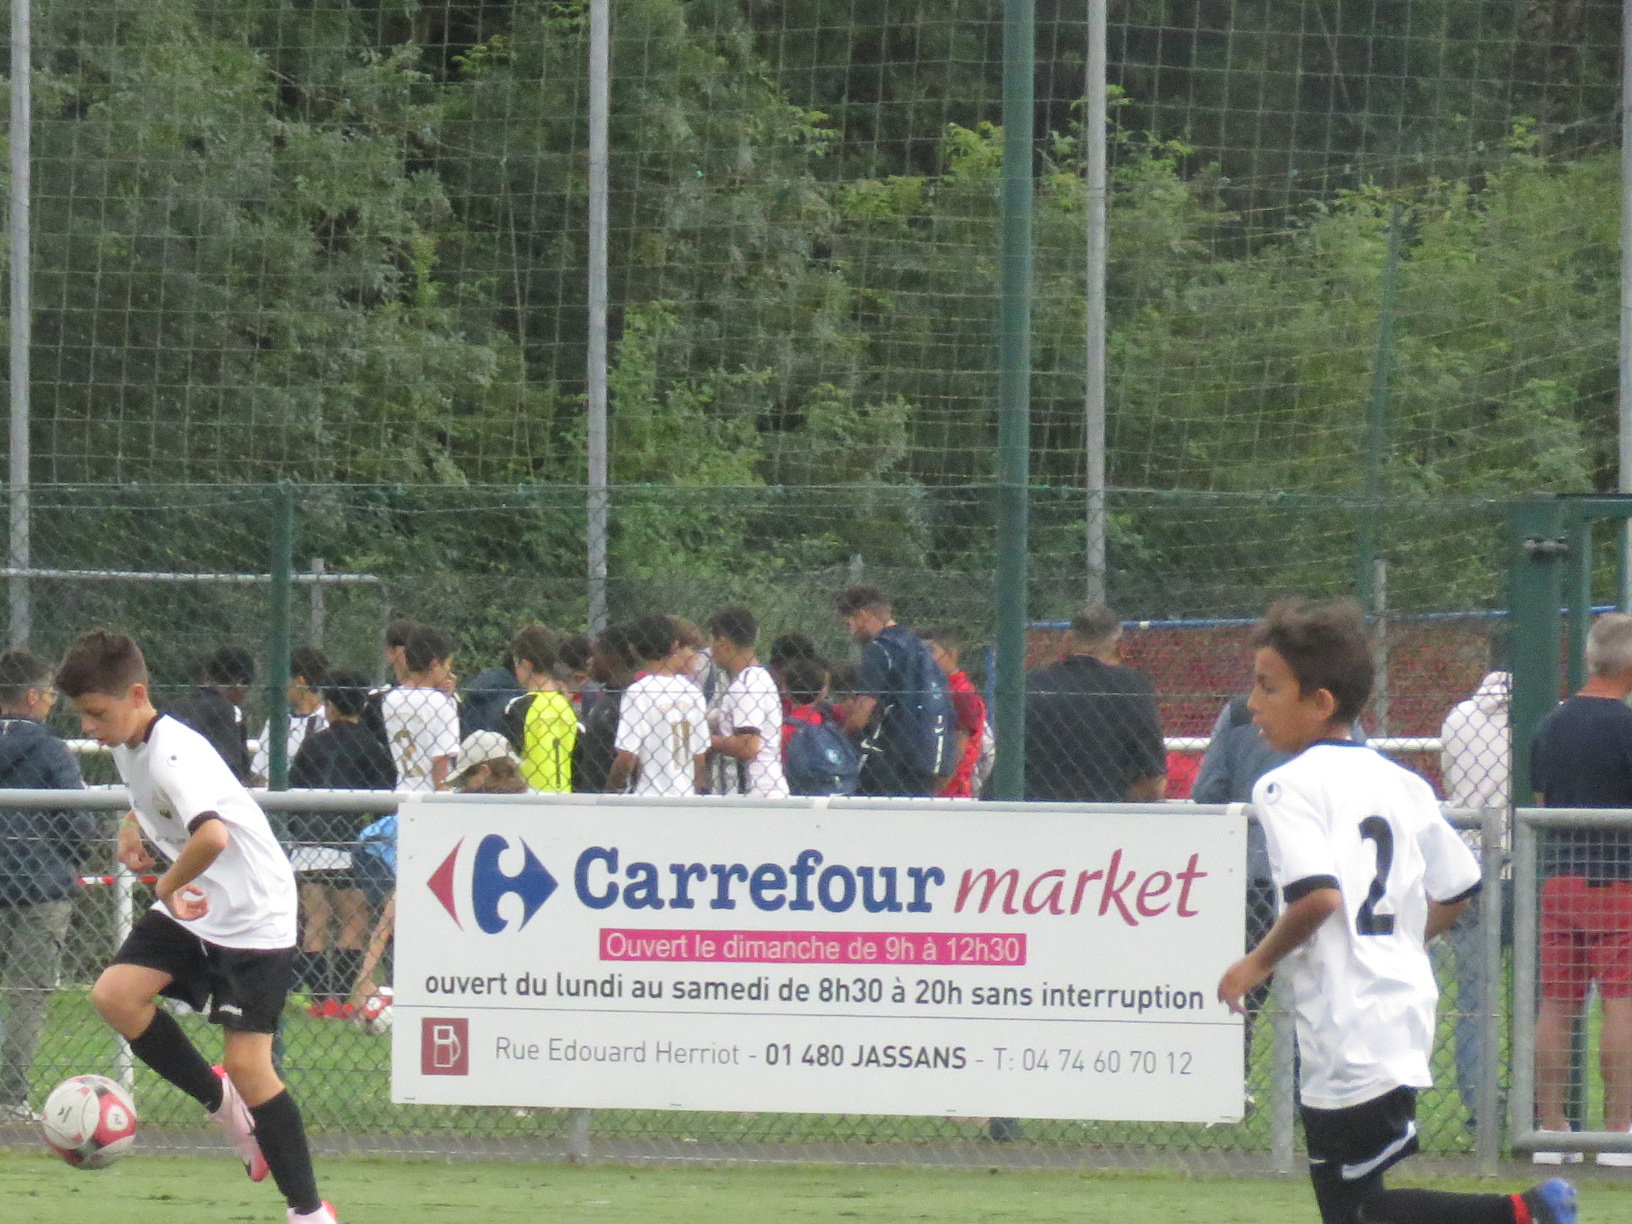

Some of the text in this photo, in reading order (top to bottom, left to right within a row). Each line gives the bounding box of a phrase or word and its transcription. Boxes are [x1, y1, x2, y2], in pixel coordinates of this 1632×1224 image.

[574, 846, 1208, 926] Carrefour market
[1356, 815, 1395, 935] 2
[606, 932, 1019, 962] Ouvert le dimanche de 9h à 12h30
[425, 972, 1204, 1014] ouvert du lundi au samedi de 8h30 à 20h sans interruption
[495, 1036, 539, 1060] Rue
[549, 1038, 646, 1063] Edouard
[656, 1041, 739, 1065] Herriot
[851, 1045, 967, 1069] JASSANS
[993, 1047, 1014, 1071] T:
[1022, 1048, 1049, 1071] 04
[1058, 1048, 1085, 1072] 74
[1093, 1050, 1121, 1073] 60
[1130, 1050, 1157, 1074] 70
[1167, 1051, 1193, 1075] 12
